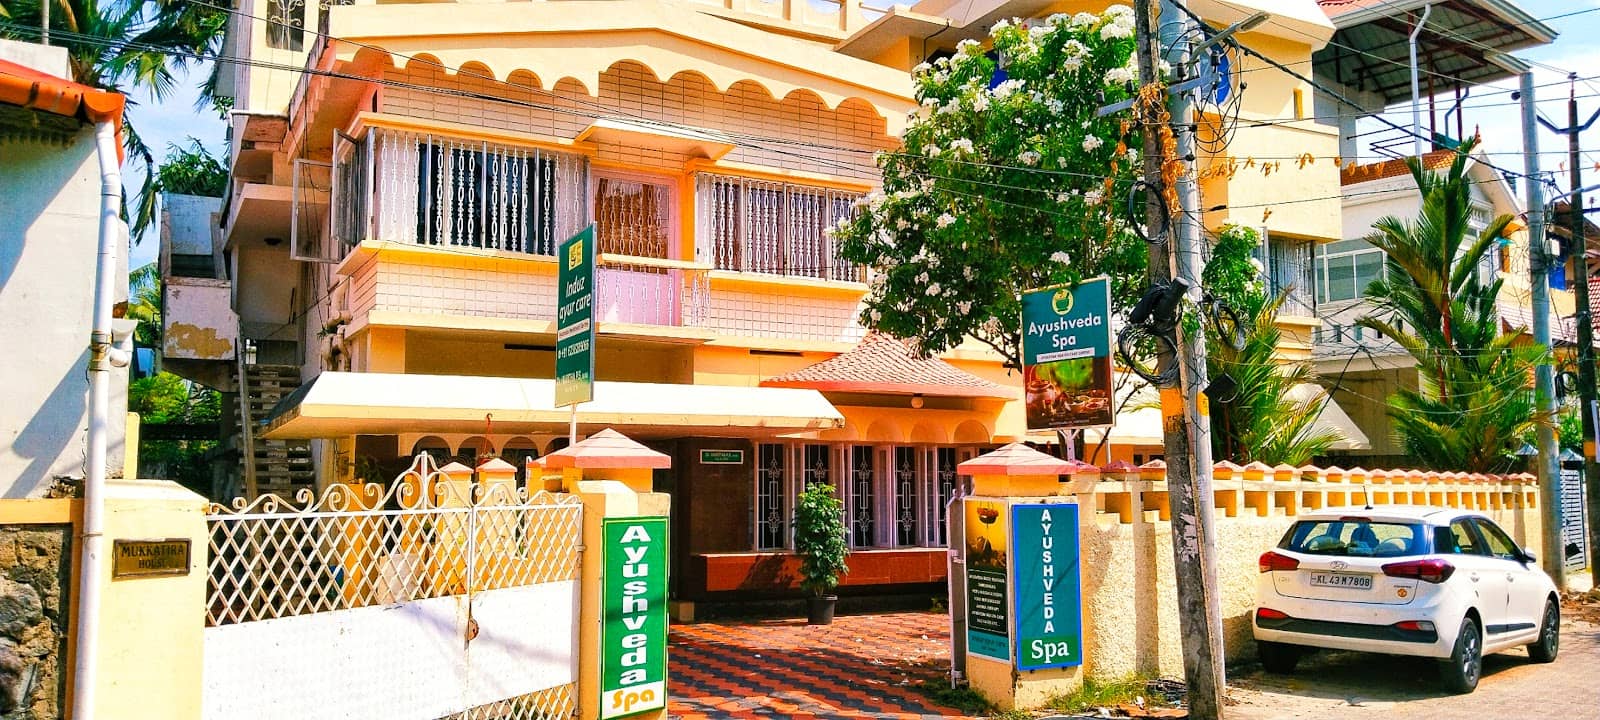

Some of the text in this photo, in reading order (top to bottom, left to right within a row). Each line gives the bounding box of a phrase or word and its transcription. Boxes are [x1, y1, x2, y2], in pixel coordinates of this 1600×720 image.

[559, 293, 591, 324] ayur care
[1028, 313, 1102, 337] Ayushveda
[1053, 334, 1076, 350] Spa
[121, 544, 184, 557] MUKKATIRA
[1041, 509, 1054, 633] AYUSHVEDA
[619, 525, 652, 685] Ayushveda
[1031, 640, 1069, 664] Spa
[612, 689, 655, 712] Spa
